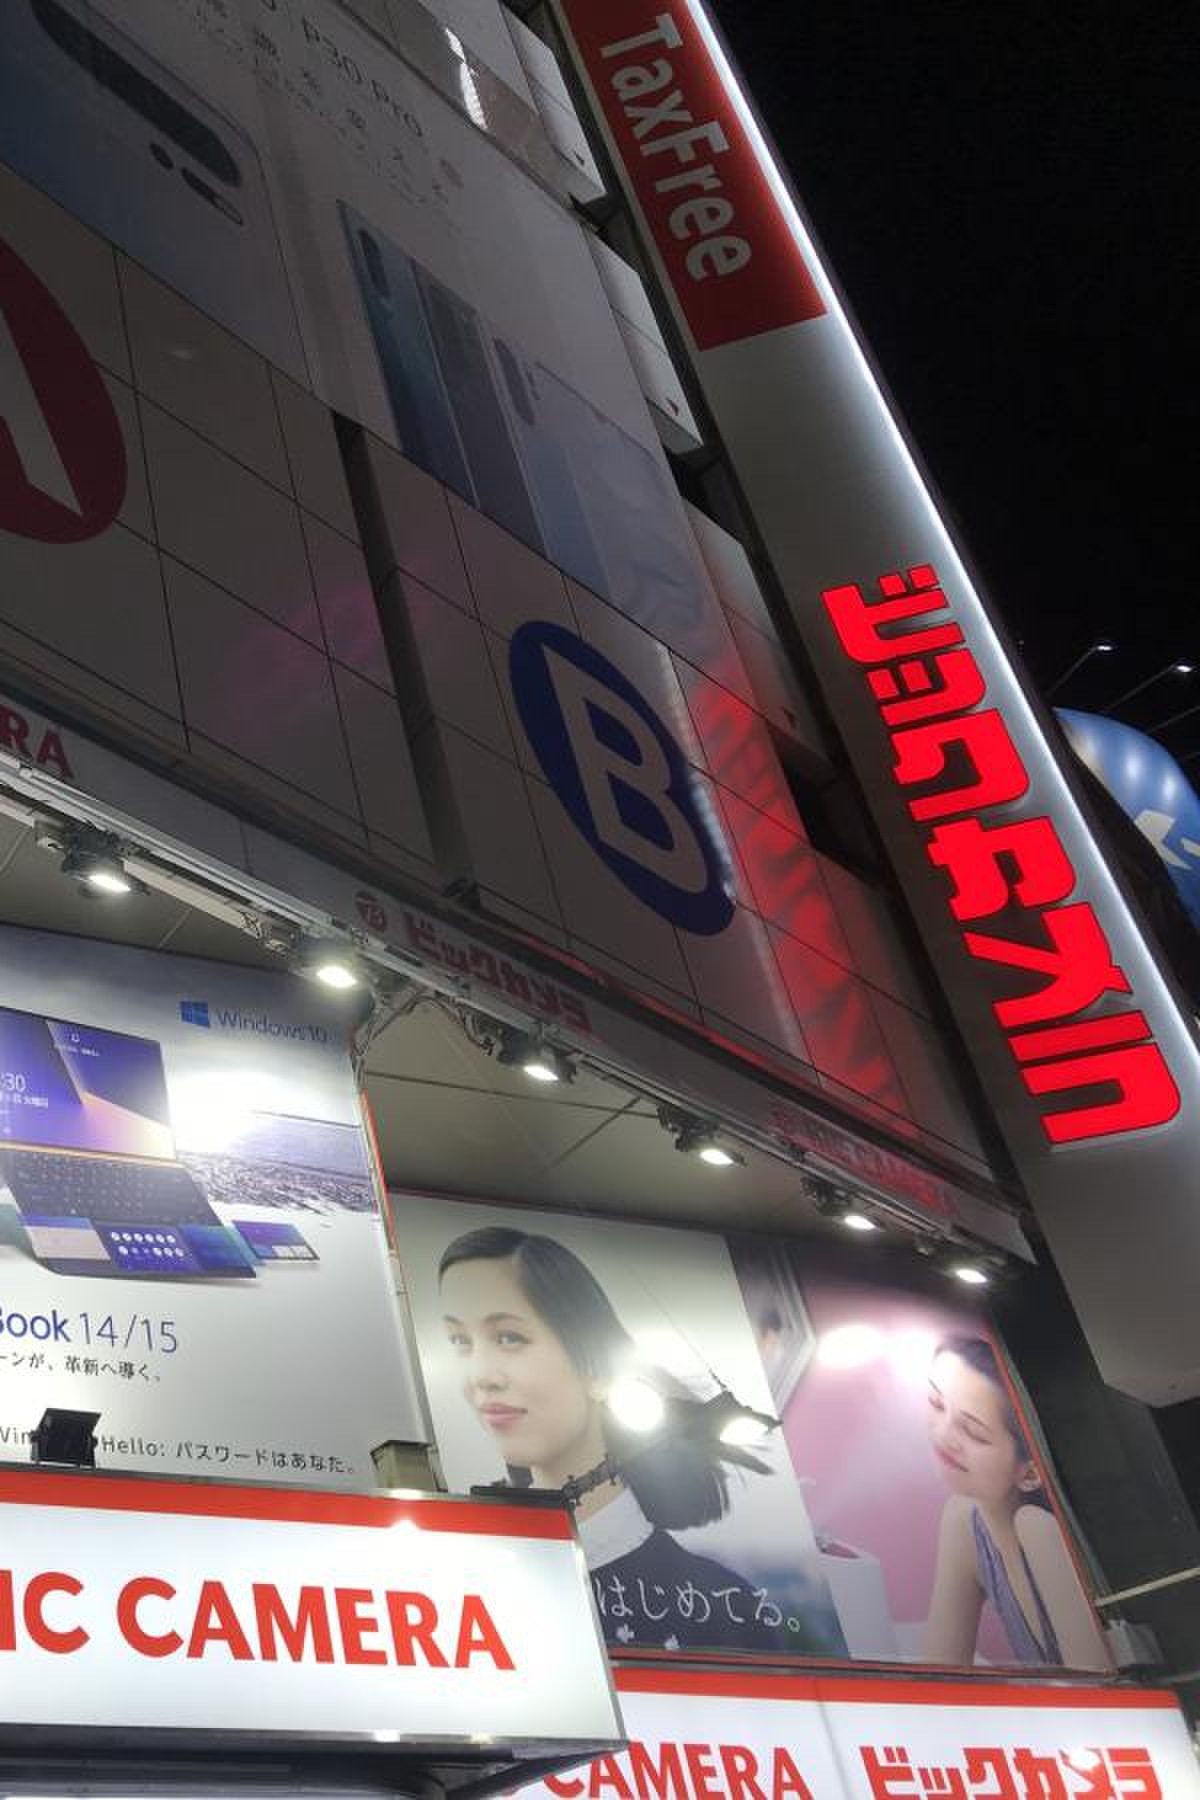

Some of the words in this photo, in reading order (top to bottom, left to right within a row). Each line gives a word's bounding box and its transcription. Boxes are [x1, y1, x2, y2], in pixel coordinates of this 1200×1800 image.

[543, 642, 709, 894] B
[820, 562, 1182, 1145] ビックカメラ
[403, 911, 593, 1034] ビックカメラ
[79, 1311, 179, 1355] 14/15
[102, 1436, 166, 1457] Hello:
[176, 1441, 354, 1474] パスワードはあなた。
[116, 1576, 517, 1671] CAMERA
[859, 1745, 1164, 1800] ビックカメラ
